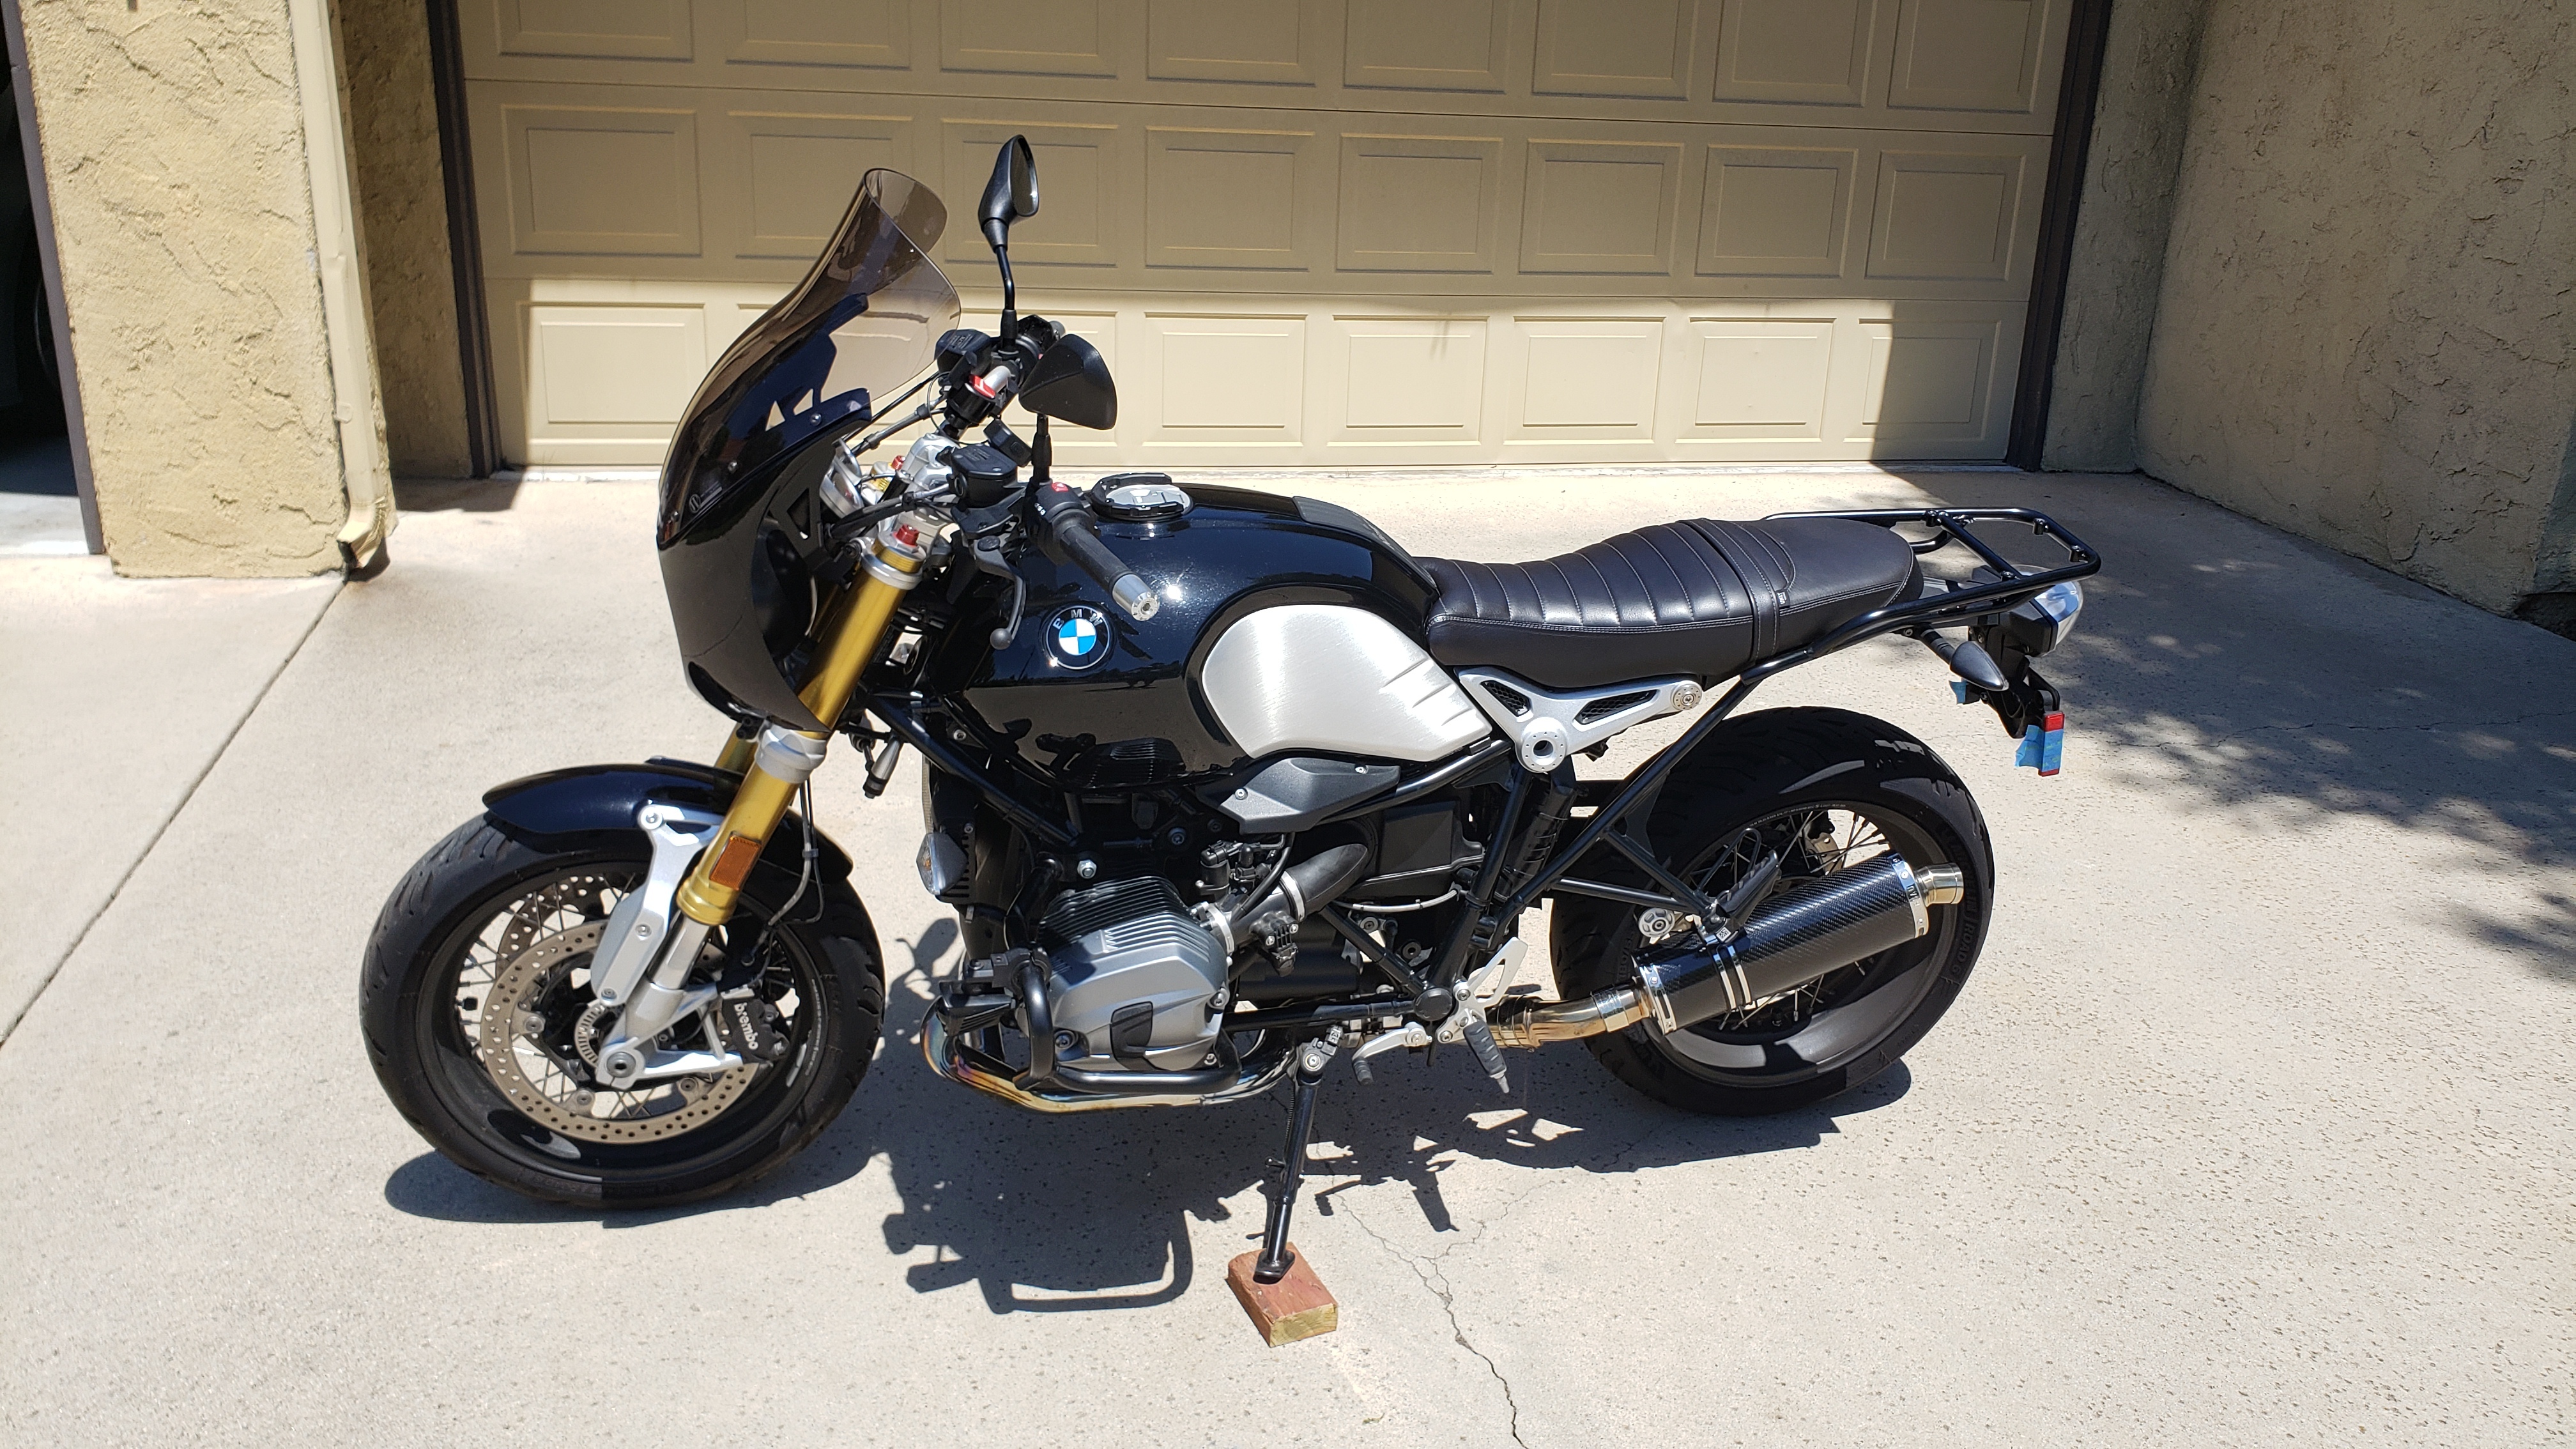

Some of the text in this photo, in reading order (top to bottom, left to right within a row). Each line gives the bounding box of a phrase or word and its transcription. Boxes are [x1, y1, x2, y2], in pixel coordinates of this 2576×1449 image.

[1053, 608, 1103, 629] BMW
[1950, 843, 1978, 976] MICHELIN ROAD 6
[734, 1002, 758, 1050] brembo
